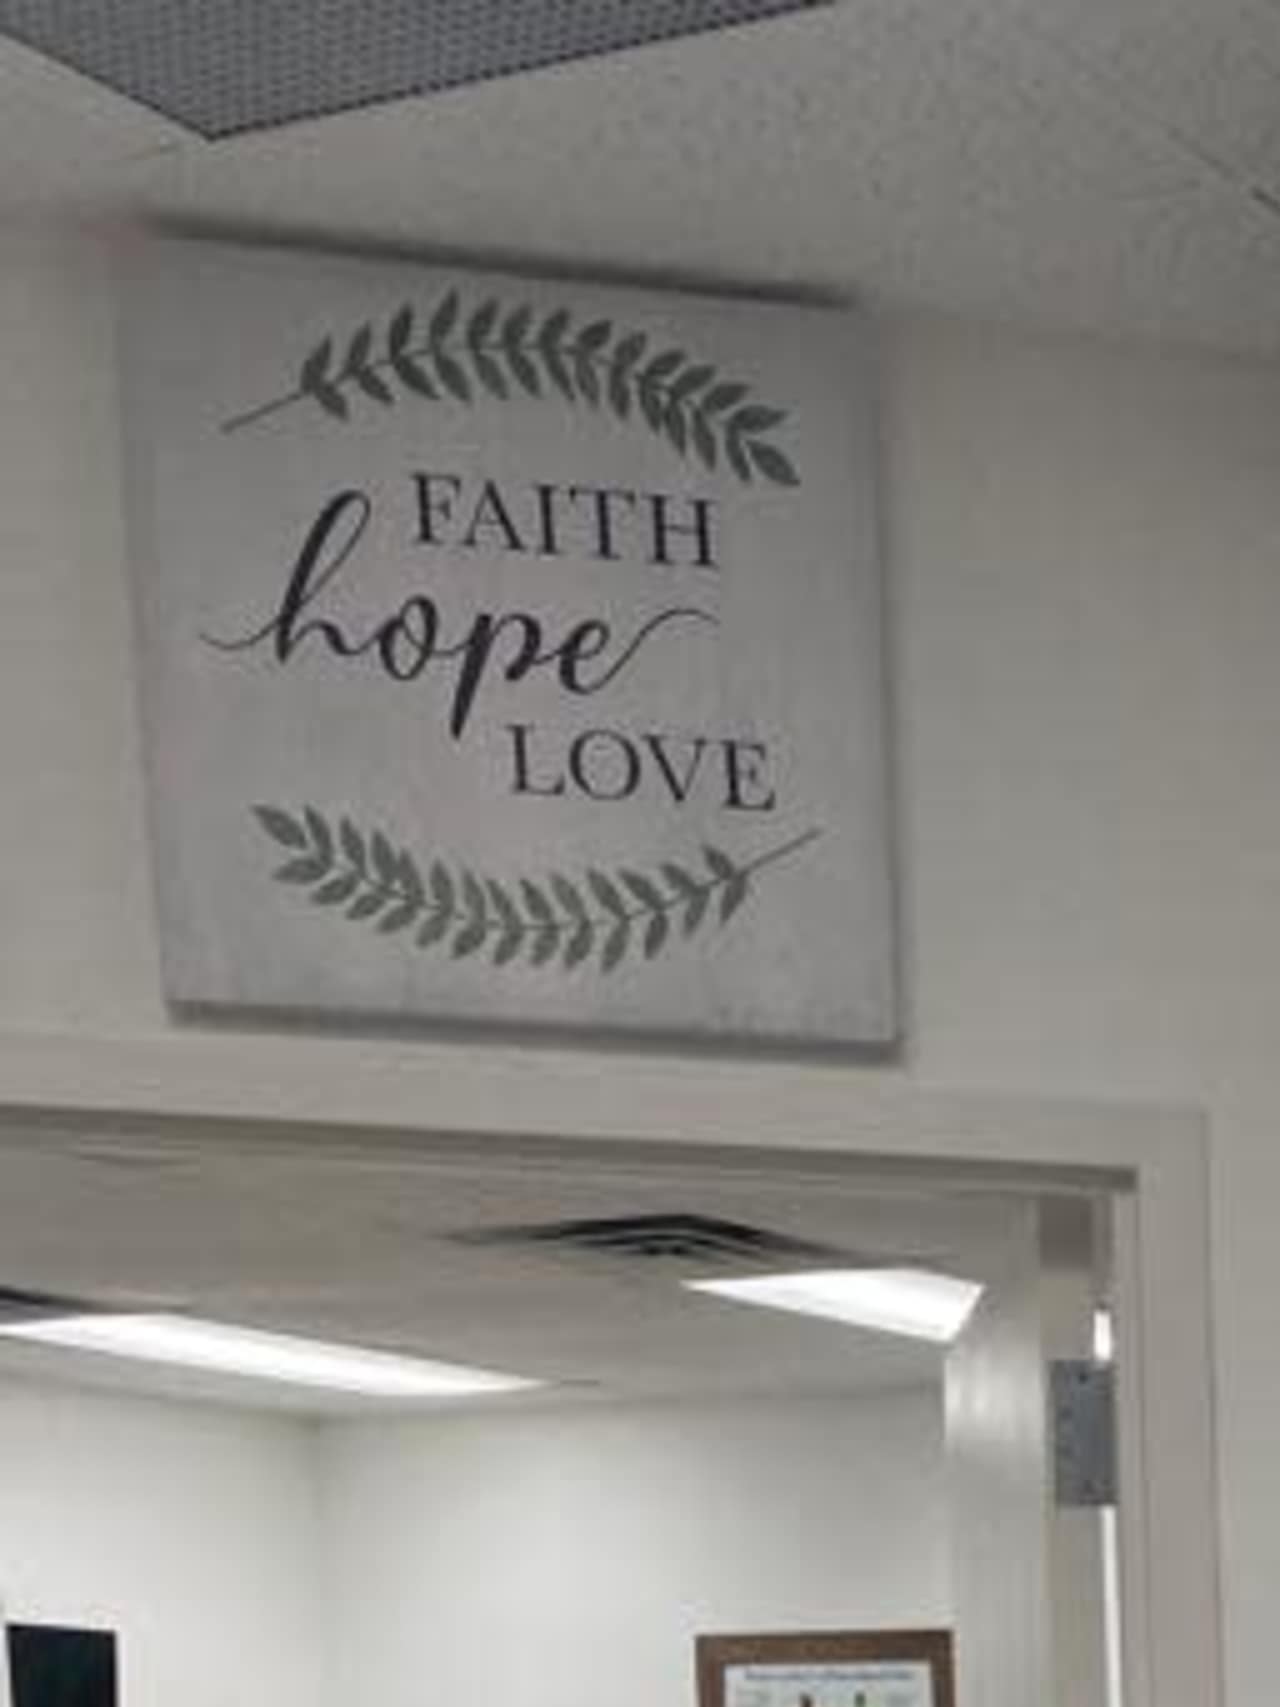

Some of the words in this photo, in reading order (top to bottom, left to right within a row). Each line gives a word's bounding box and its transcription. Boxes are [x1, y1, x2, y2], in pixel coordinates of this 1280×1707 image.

[411, 471, 720, 570] FAITH
[200, 490, 720, 740] hope
[506, 724, 776, 812] LOVE
